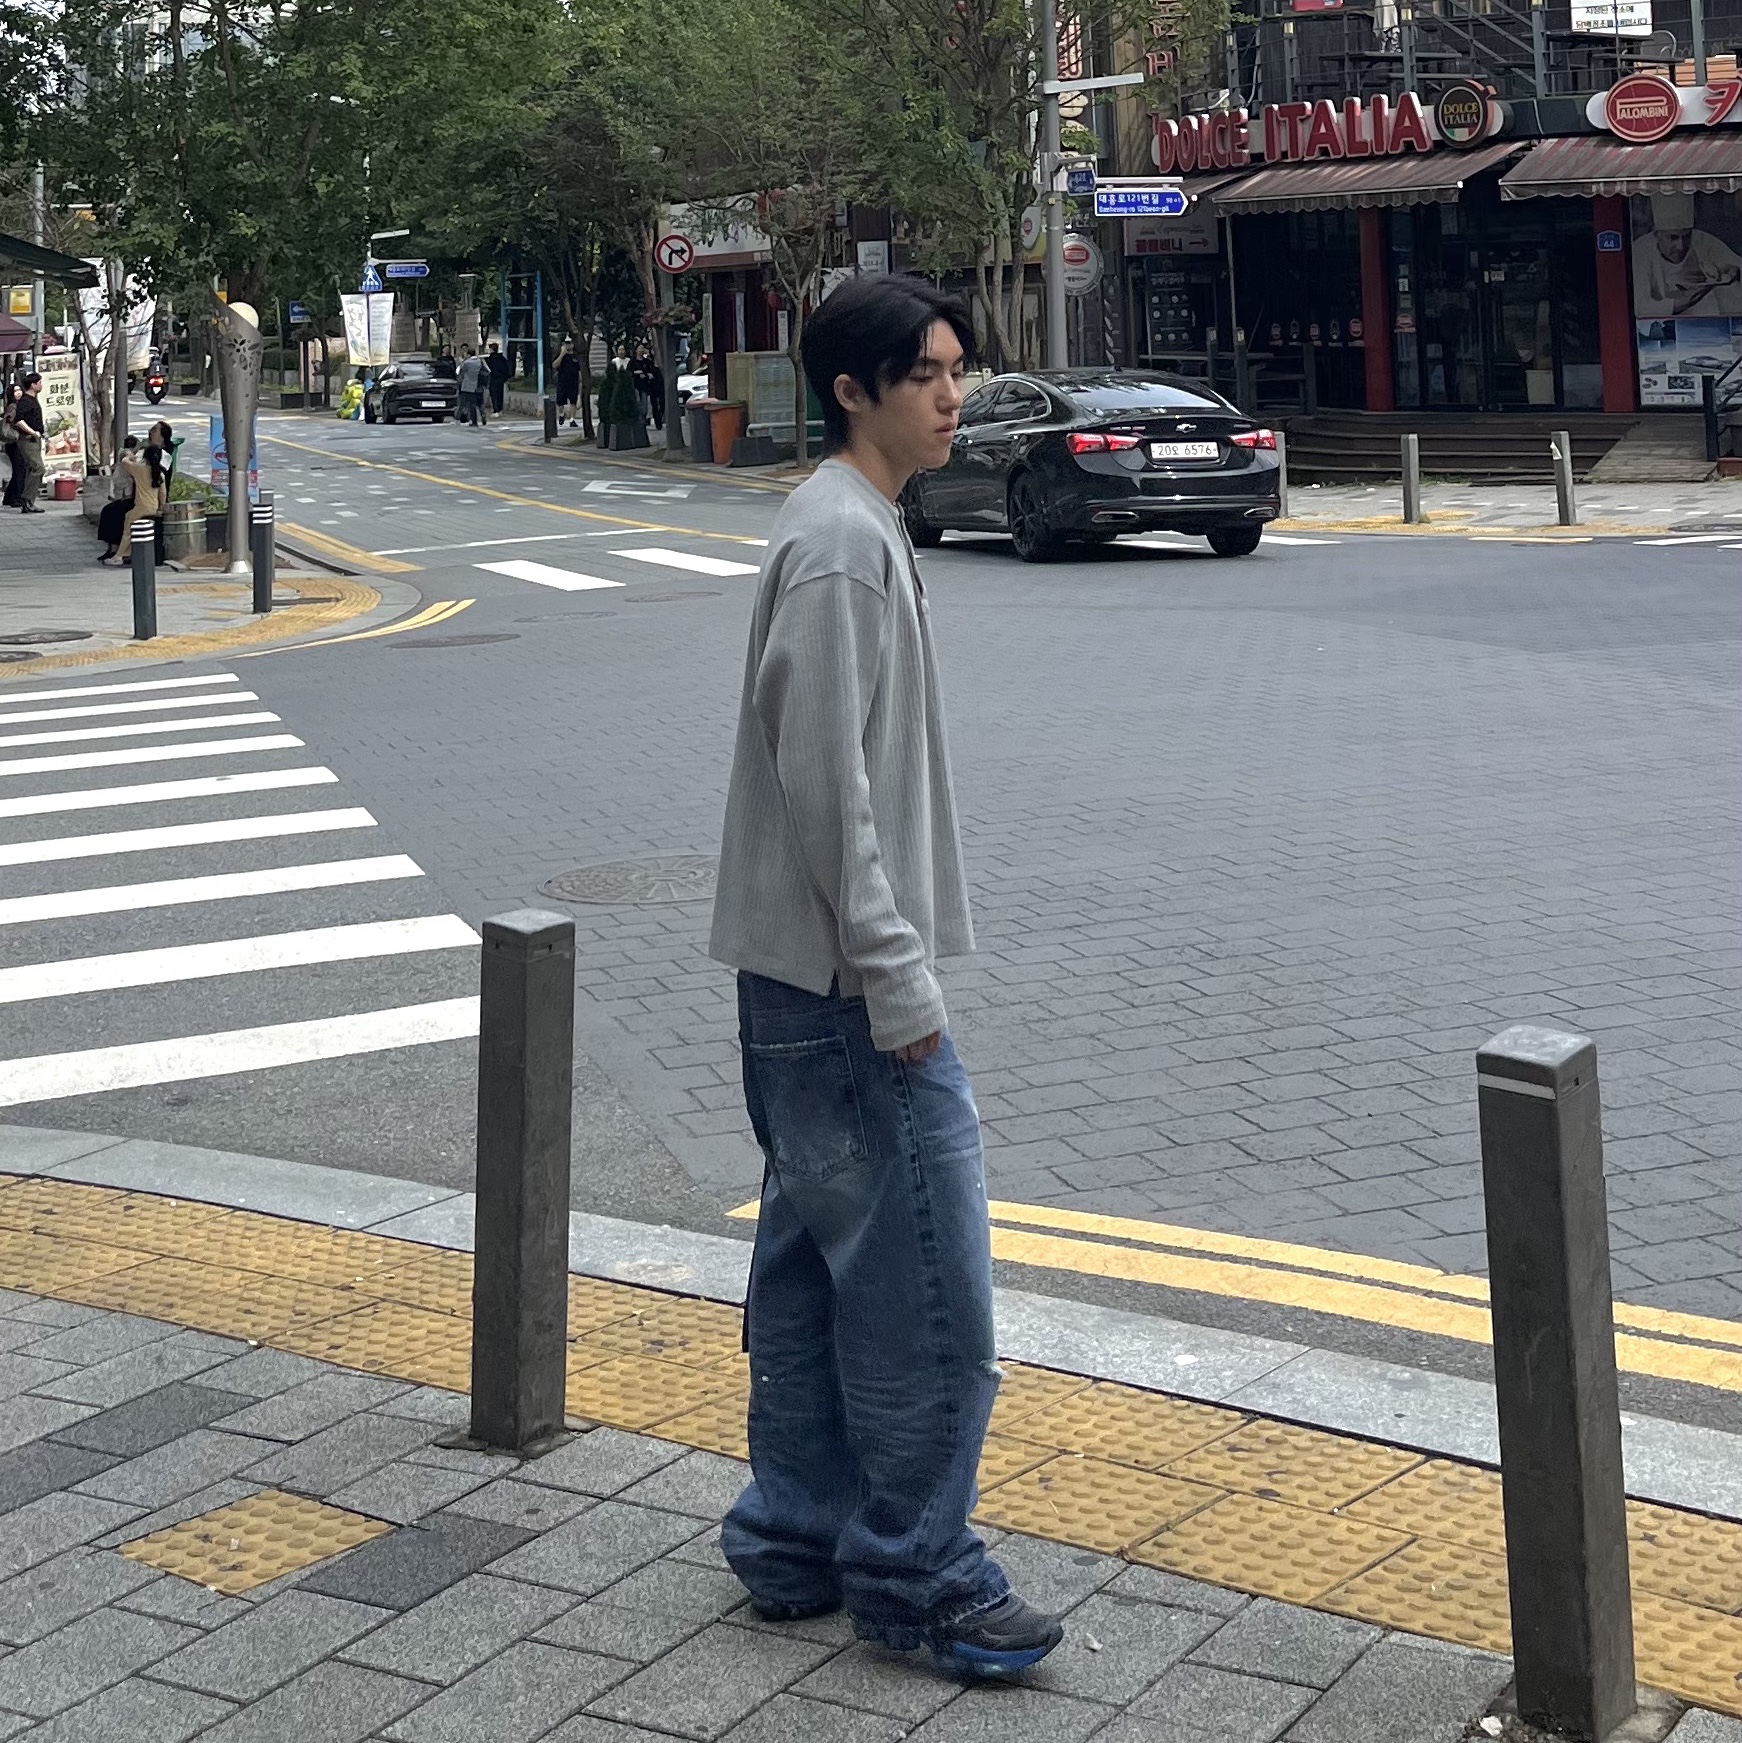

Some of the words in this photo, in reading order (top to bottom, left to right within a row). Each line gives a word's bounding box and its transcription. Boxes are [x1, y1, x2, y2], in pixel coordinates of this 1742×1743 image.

[1443, 102, 1478, 114] DOLCE
[1616, 97, 1669, 119] PALOMBINI
[1443, 113, 1478, 125] ITALIA
[1158, 108, 1249, 173] DOLCE
[1263, 91, 1432, 163] ITALIA
[1184, 444, 1212, 456] 6576
